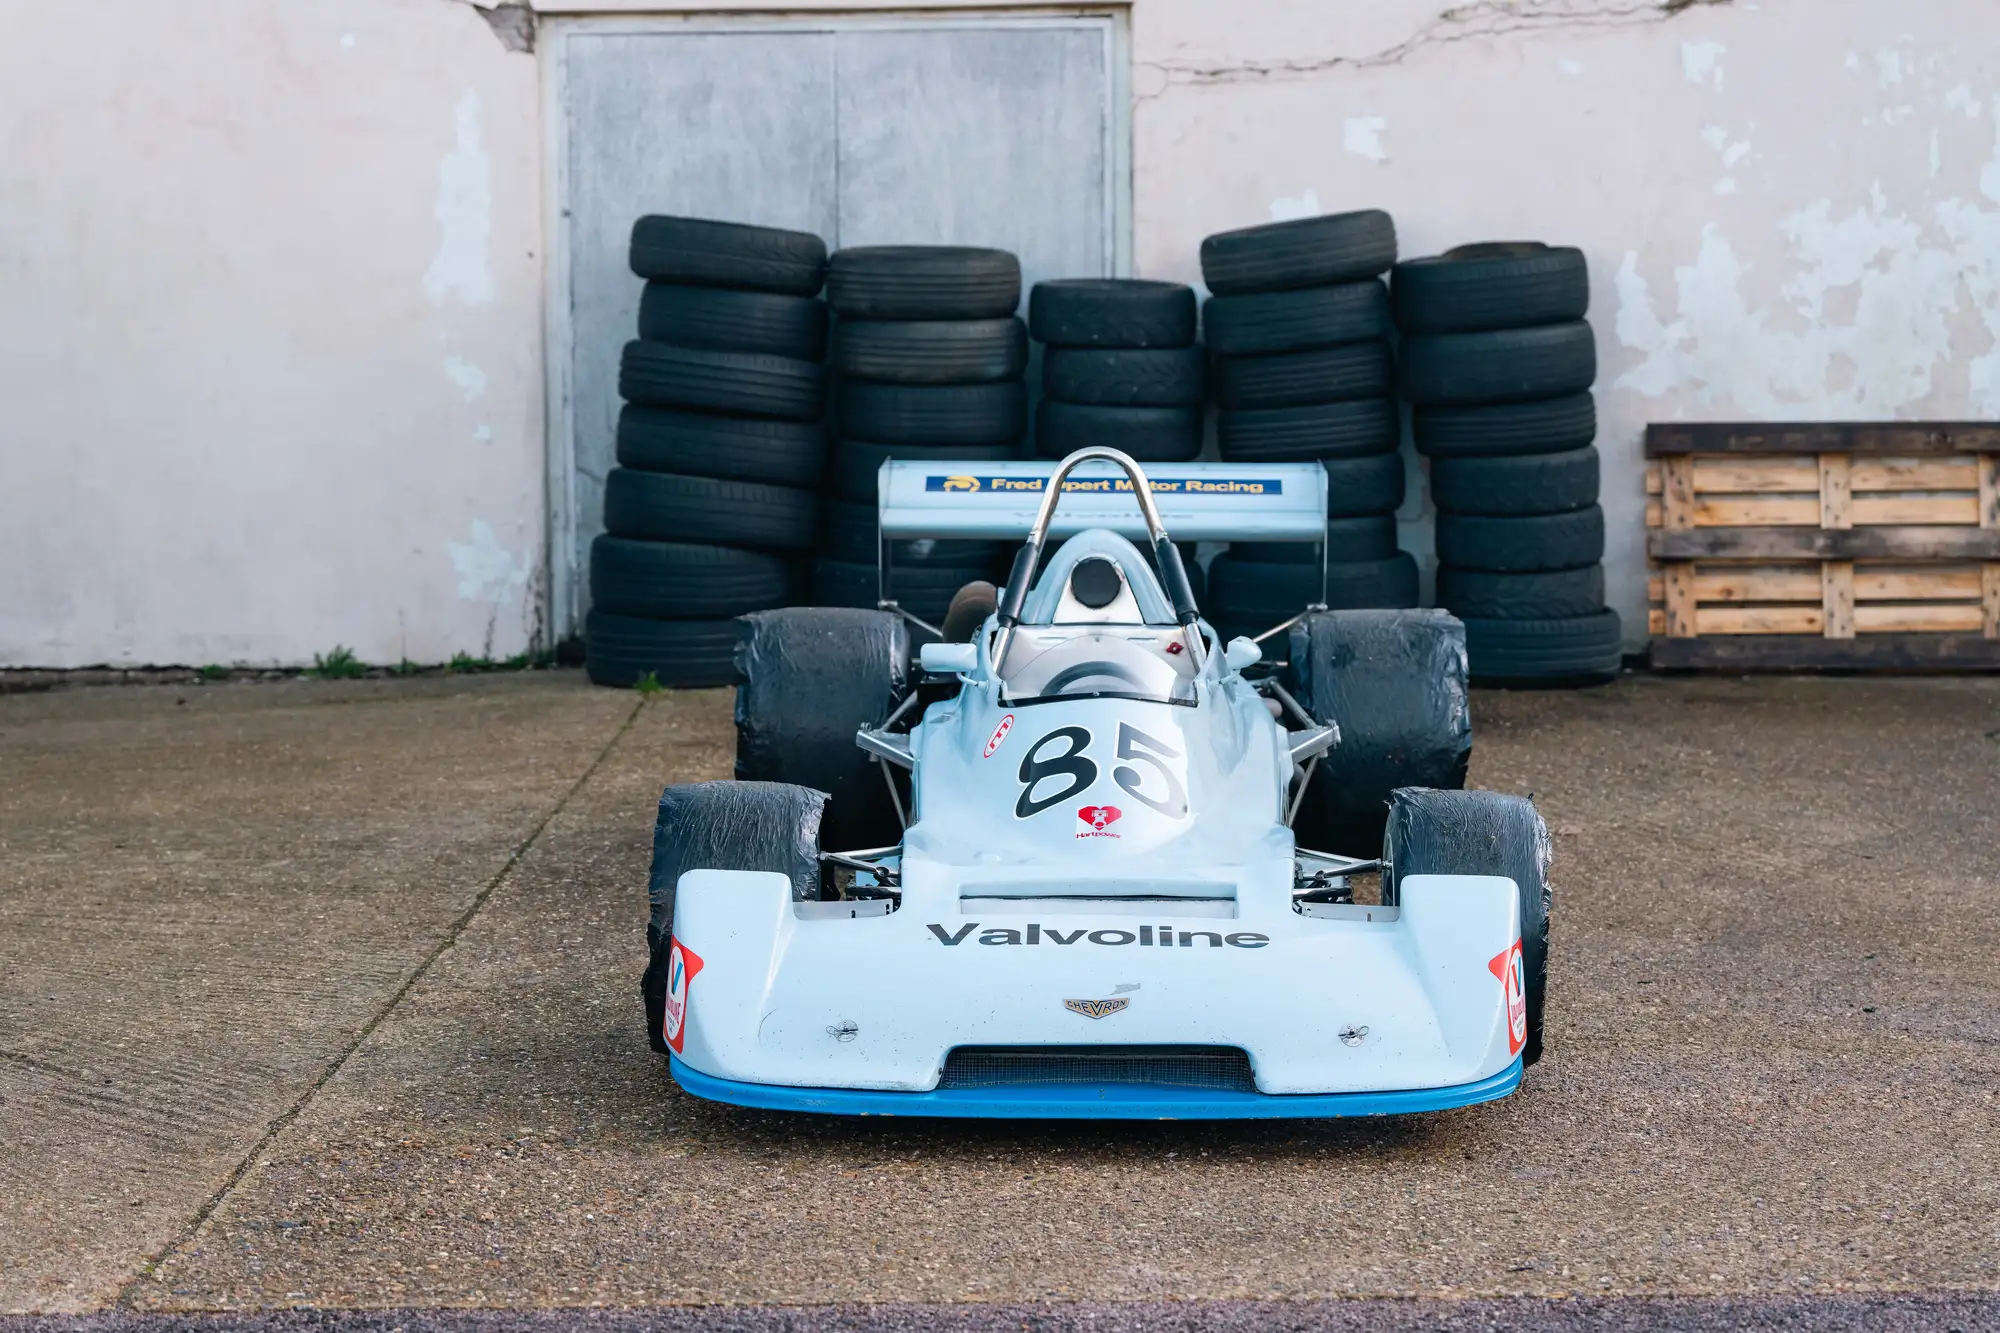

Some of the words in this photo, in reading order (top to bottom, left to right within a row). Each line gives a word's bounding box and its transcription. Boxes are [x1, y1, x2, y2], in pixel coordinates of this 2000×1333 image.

[991, 478, 1042, 490] Fred
[1061, 480, 1110, 492] pert
[1115, 479, 1181, 491] Mtor
[1185, 480, 1264, 493] Racing
[1015, 721, 1188, 820] 85
[1076, 831, 1122, 839] Hartpower
[925, 922, 1271, 949] Valvoline
[1067, 999, 1126, 1015] CHEVRON
